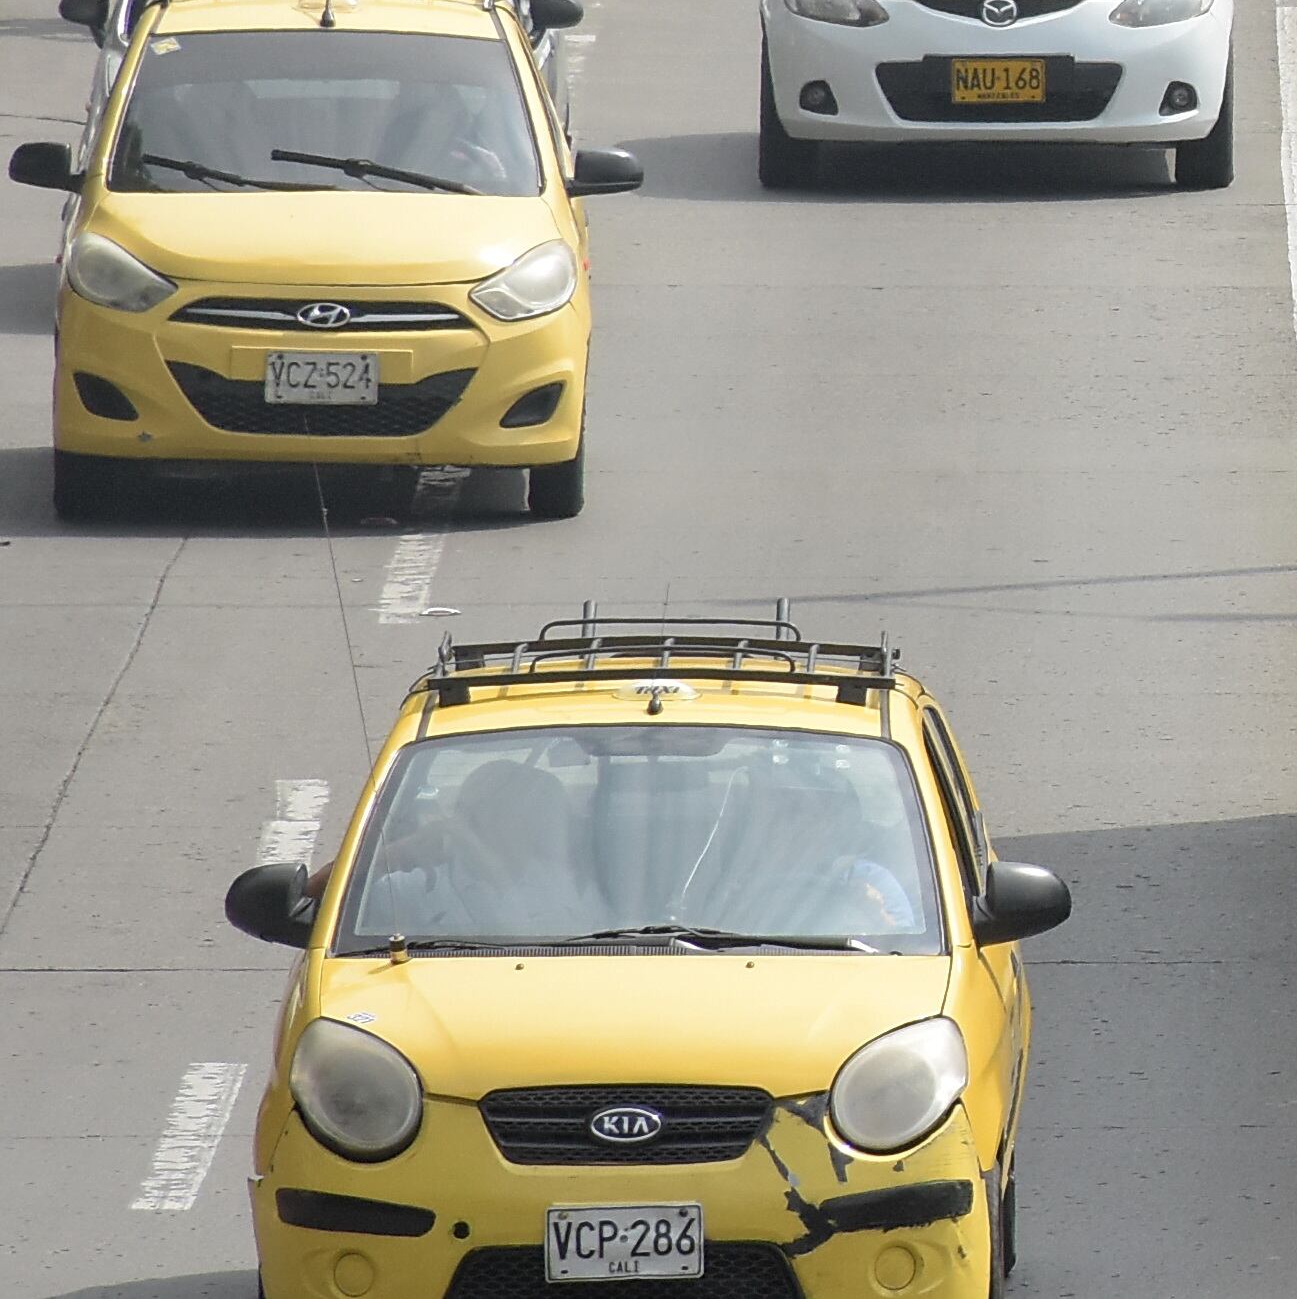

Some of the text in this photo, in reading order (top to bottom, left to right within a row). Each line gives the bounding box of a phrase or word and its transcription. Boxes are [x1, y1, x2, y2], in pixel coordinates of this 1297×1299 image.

[635, 685, 680, 695] TAXI
[602, 1116, 650, 1134] KIA
[608, 1260, 640, 1273] CALI
